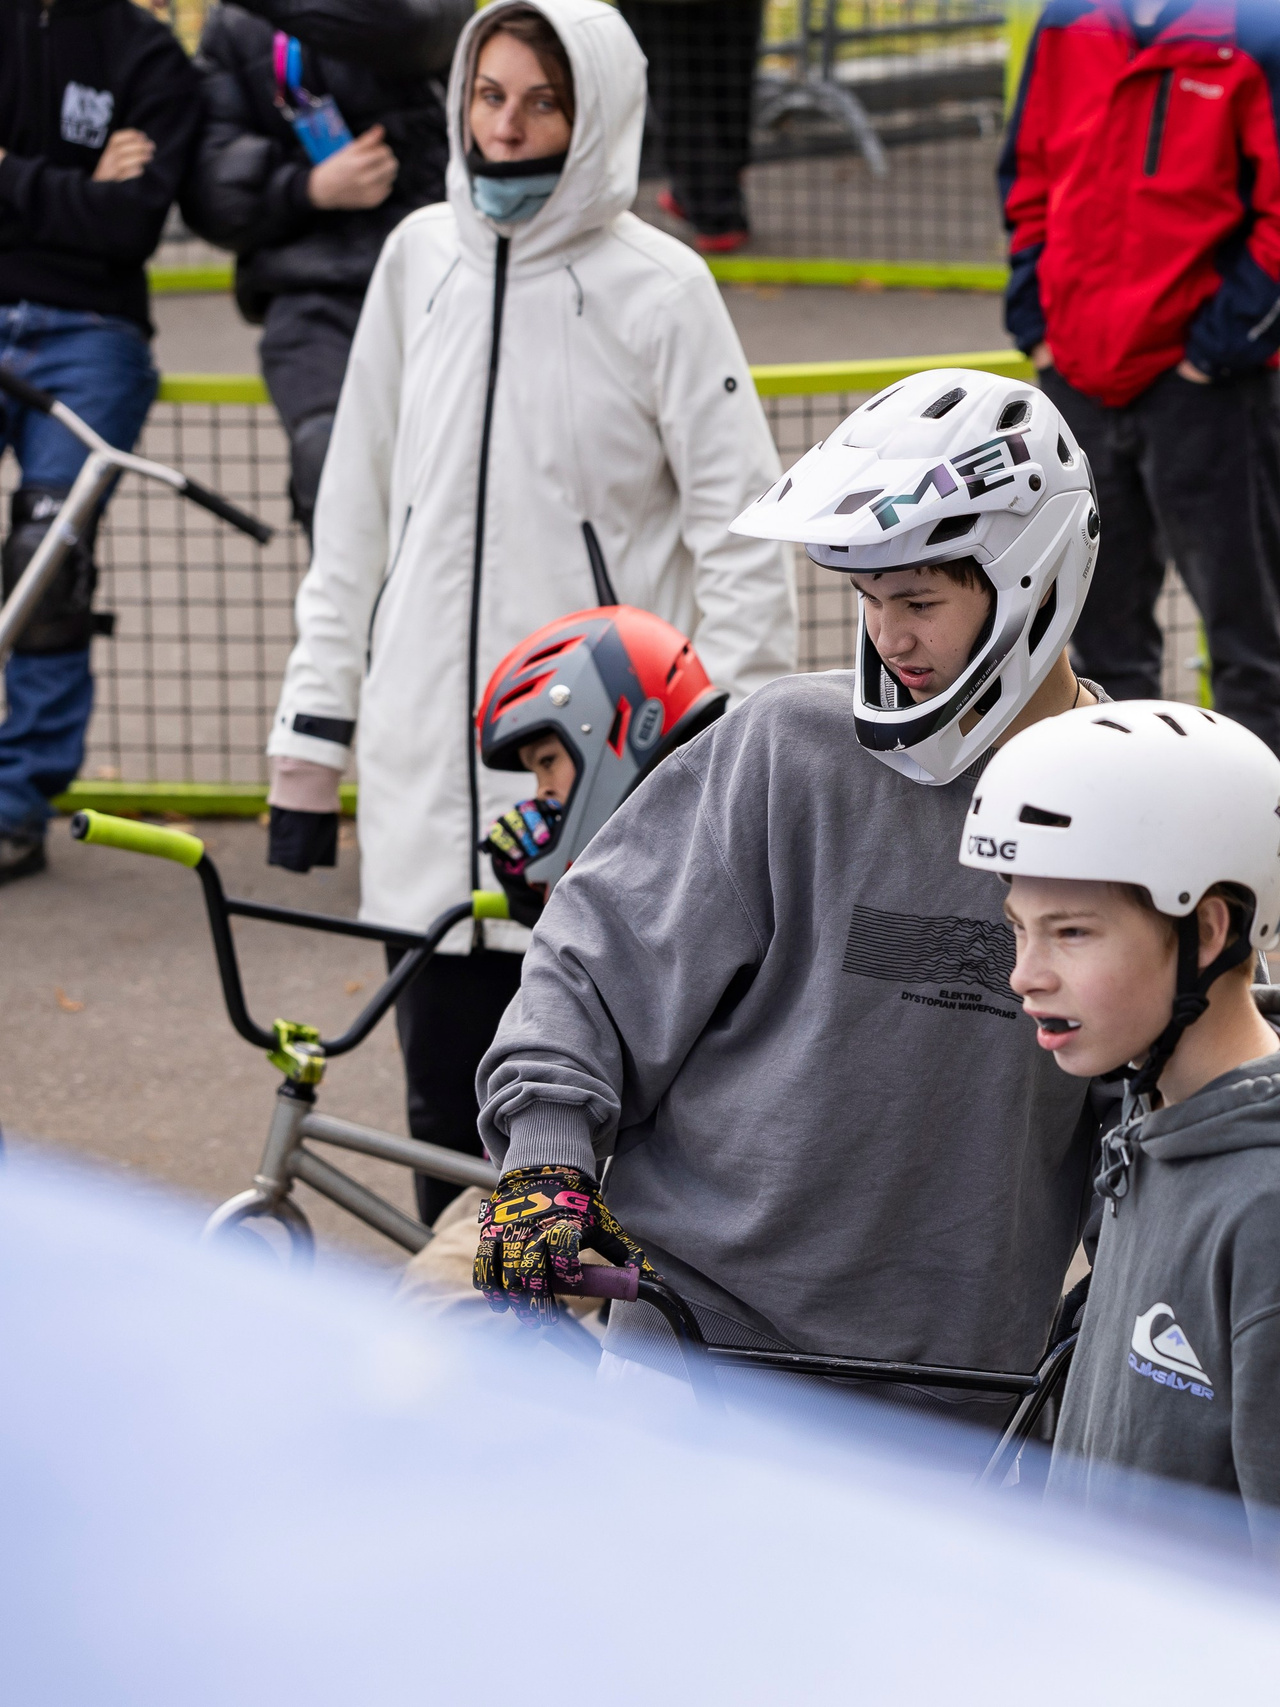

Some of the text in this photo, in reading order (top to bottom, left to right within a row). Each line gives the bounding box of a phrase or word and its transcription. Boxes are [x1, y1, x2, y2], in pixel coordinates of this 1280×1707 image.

[869, 427, 1031, 531] MET
[901, 991, 1017, 1020] DYSTOPIAN WAVEFORMS
[939, 989, 983, 1002] ELEKTRO
[1128, 1352, 1215, 1400] QUIKSILVER
